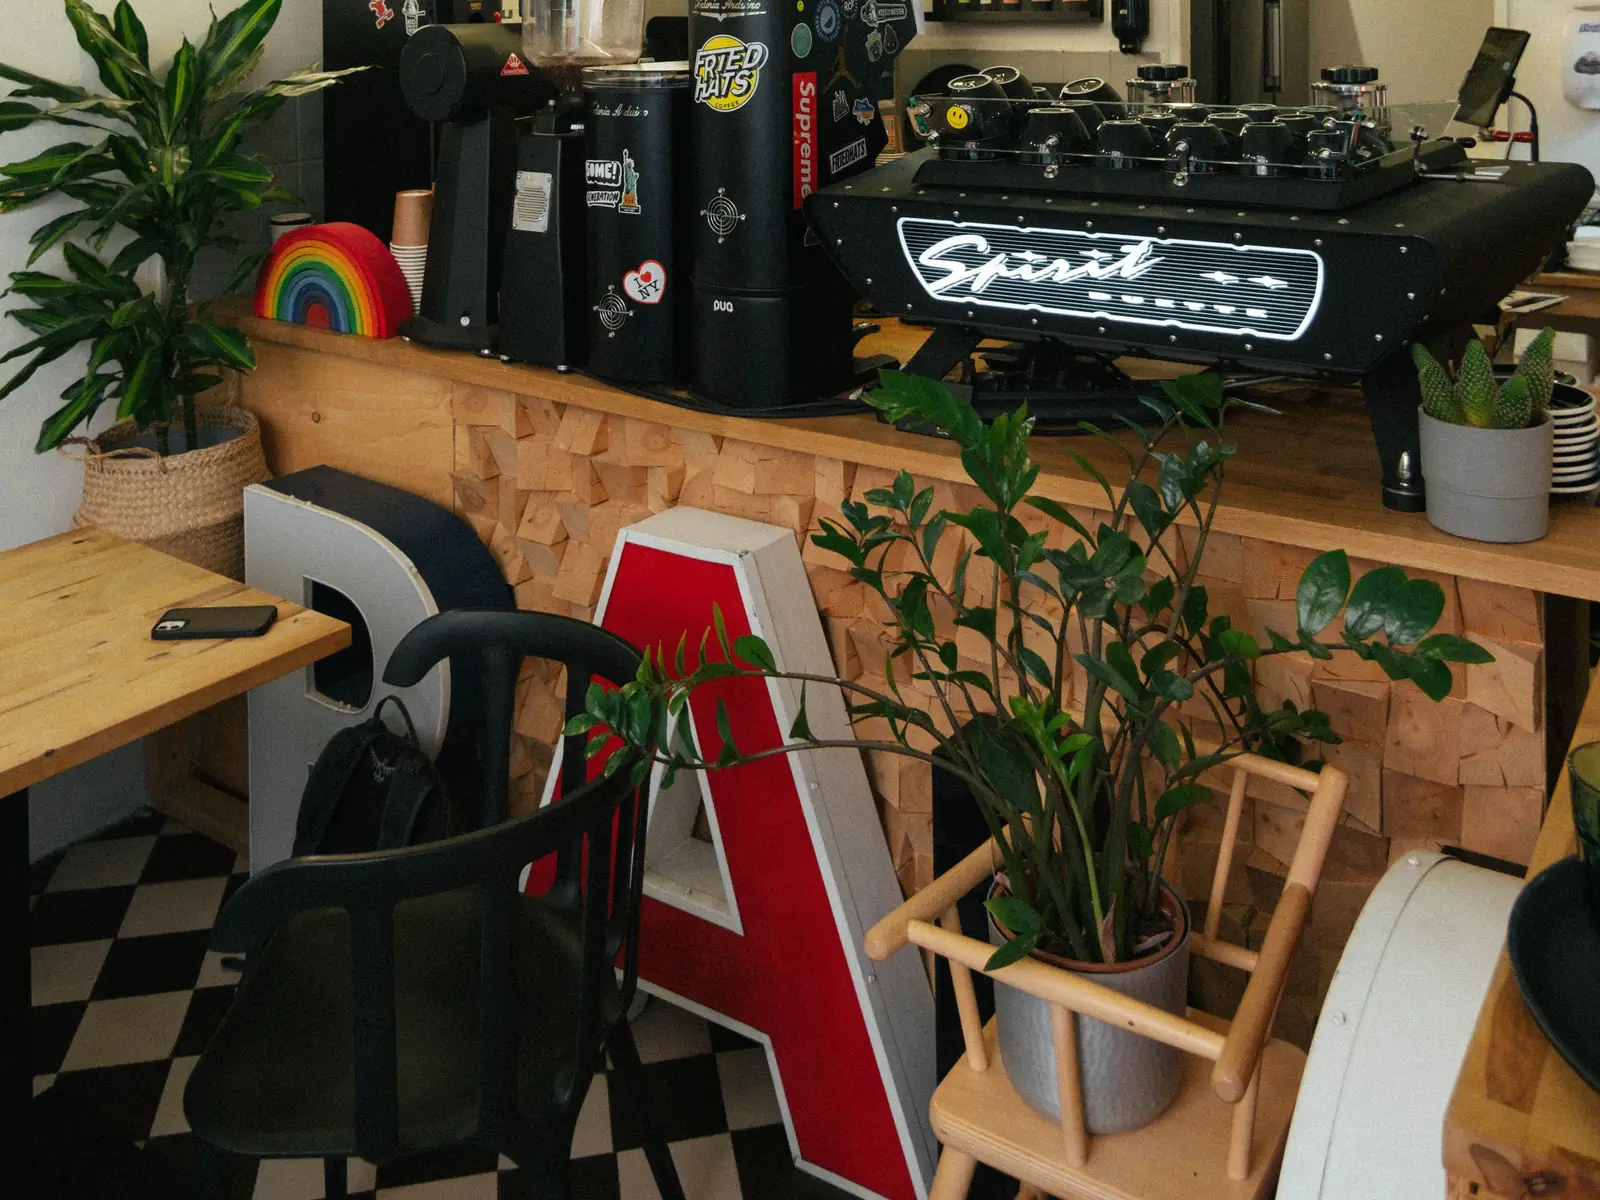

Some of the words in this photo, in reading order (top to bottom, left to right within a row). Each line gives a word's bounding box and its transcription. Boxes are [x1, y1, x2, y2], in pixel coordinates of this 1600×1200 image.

[695, 44, 763, 81] FRIED
[696, 70, 752, 101] HATS
[714, 100, 740, 109] COFFEE
[796, 80, 815, 199] Supreme
[918, 234, 1165, 294] Spirit
[633, 276, 643, 289] I
[638, 279, 660, 300] NY
